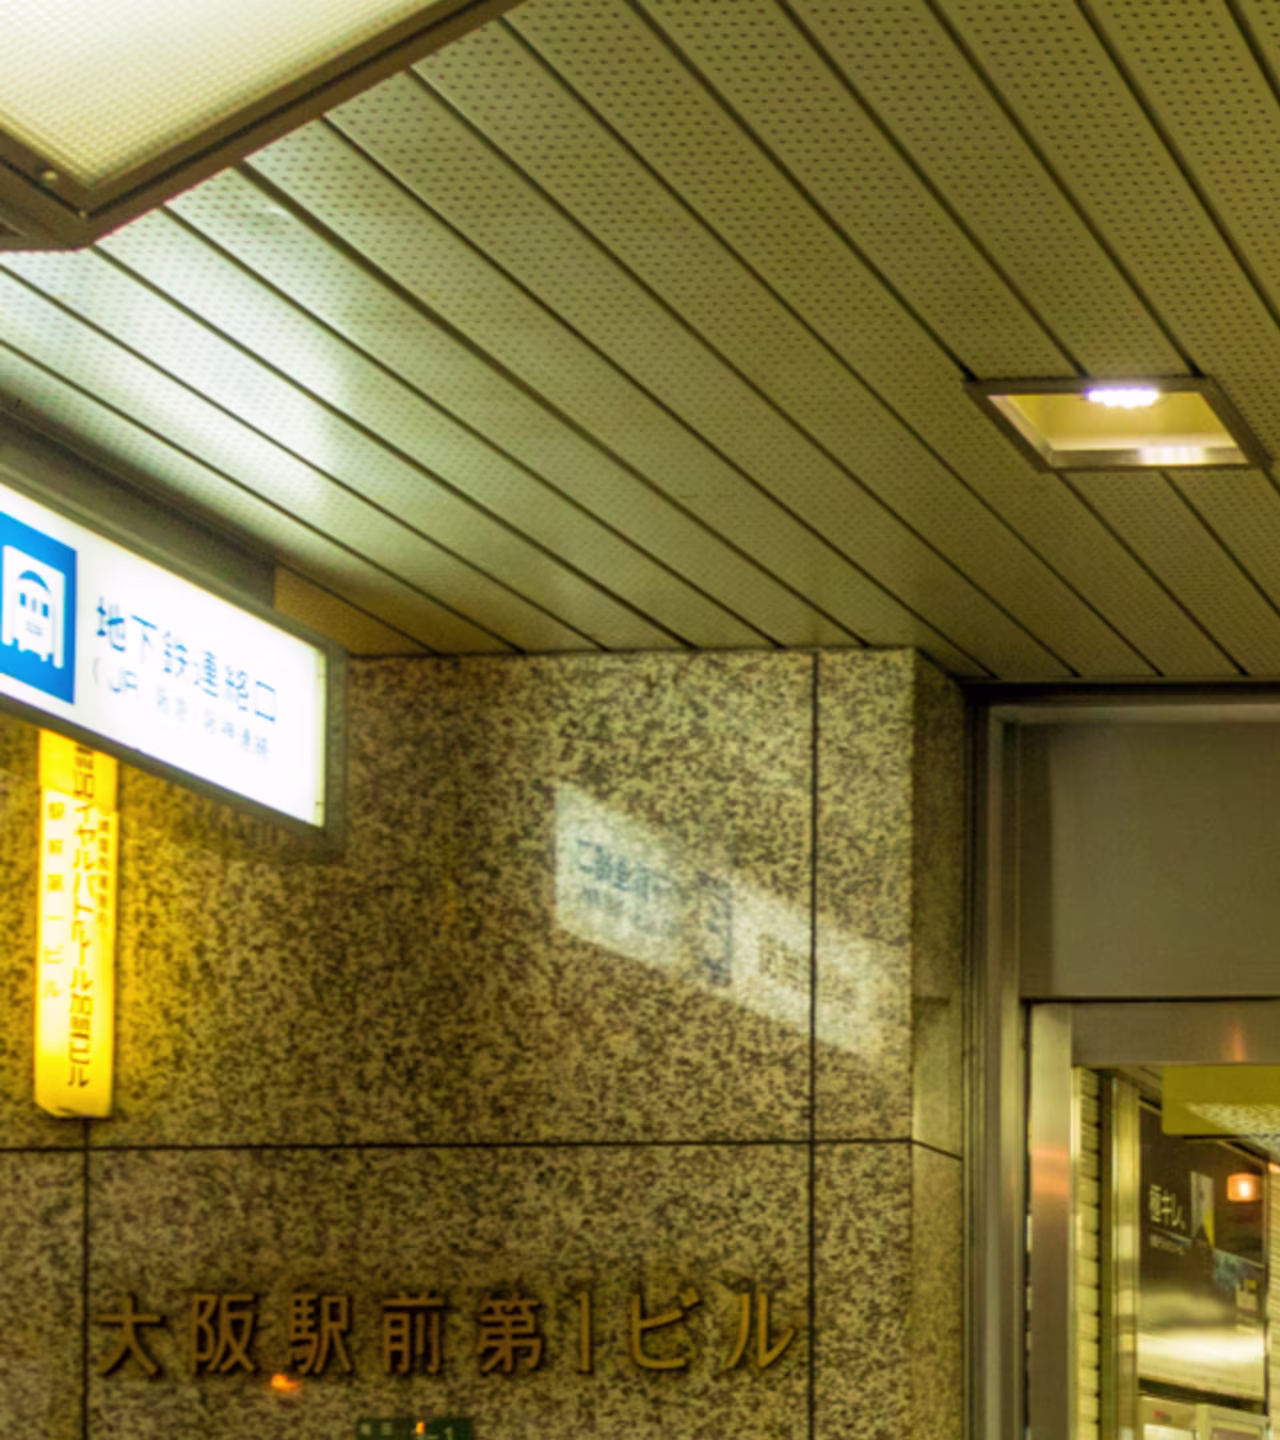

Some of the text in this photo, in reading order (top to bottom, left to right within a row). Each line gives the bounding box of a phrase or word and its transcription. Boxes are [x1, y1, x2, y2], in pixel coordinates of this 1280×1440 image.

[96, 1286, 797, 1376] 大阪駅前第1ビル
